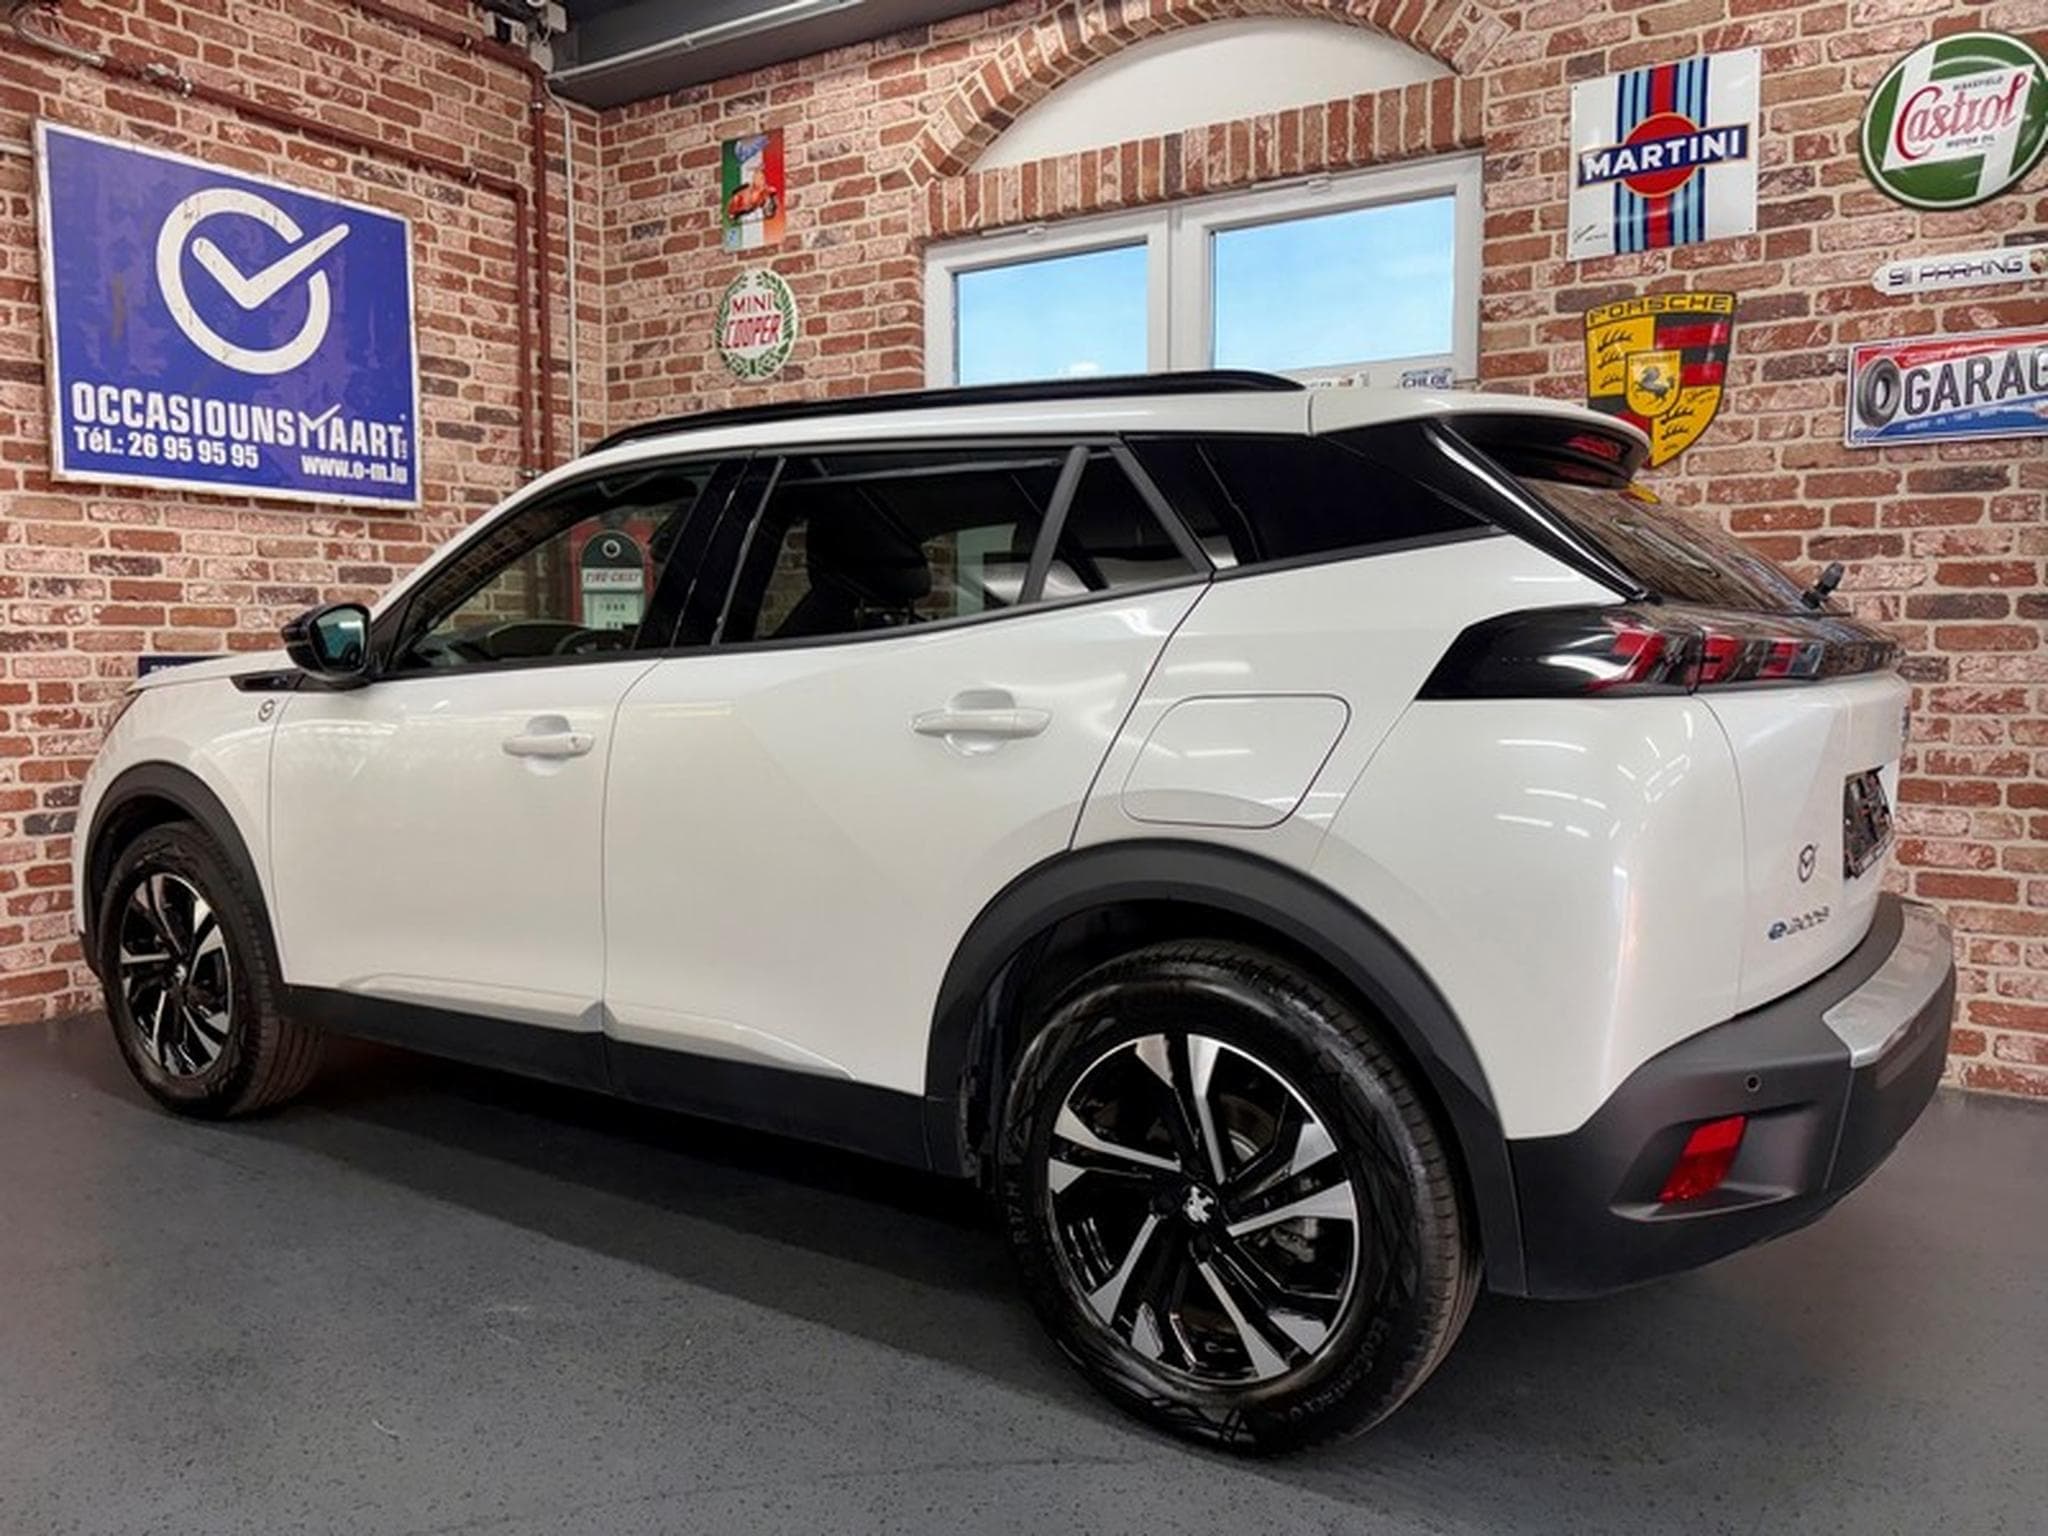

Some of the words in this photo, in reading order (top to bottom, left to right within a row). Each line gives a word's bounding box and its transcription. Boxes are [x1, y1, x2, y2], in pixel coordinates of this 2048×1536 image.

[1896, 72, 2028, 160] Castrol
[1583, 130, 1740, 181] MARTINI
[1919, 254, 2024, 284] PARKING
[732, 294, 774, 313] MINI
[1589, 296, 1729, 325] PORSCHE
[722, 313, 782, 349] COOPER
[127, 431, 158, 459] 26
[162, 434, 194, 462] 95
[197, 439, 227, 466] 95
[230, 444, 260, 470] 95
